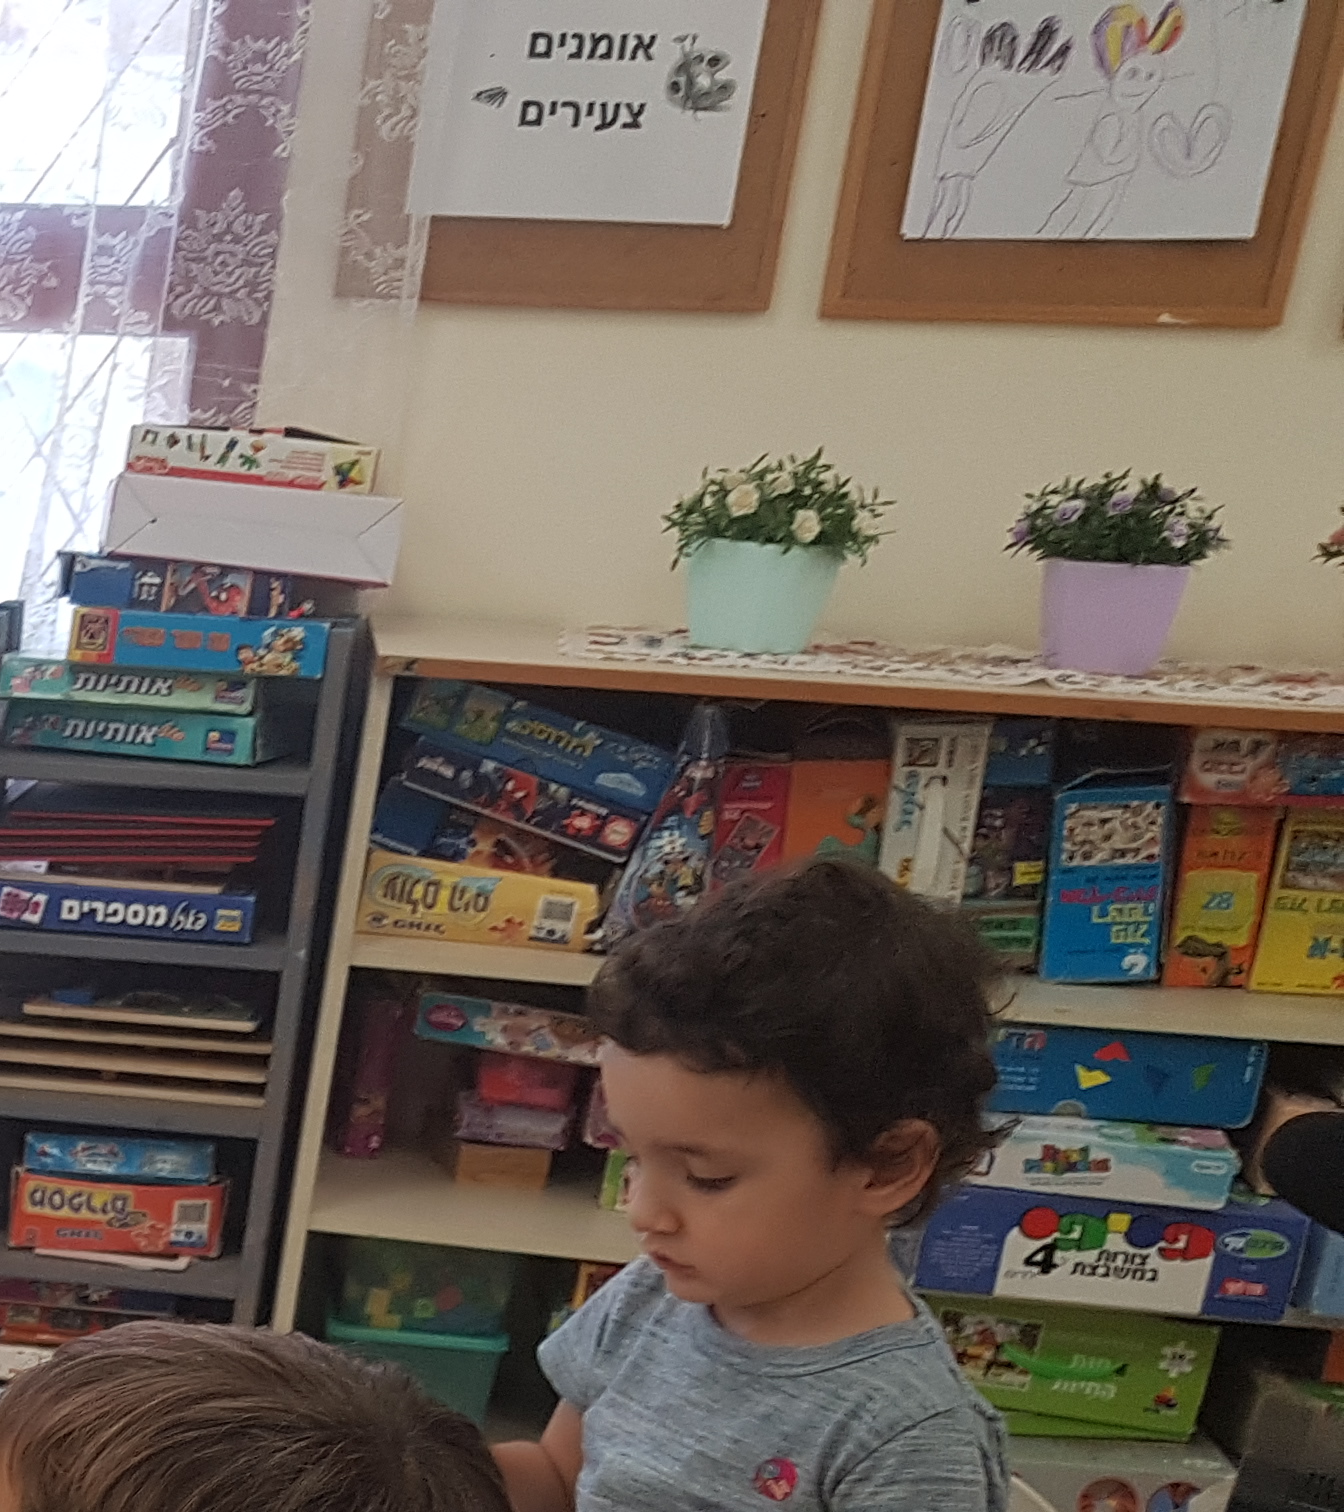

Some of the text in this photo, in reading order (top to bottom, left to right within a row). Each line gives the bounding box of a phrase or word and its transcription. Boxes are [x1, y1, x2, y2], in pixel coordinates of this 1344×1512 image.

[528, 32, 658, 61] אומנים
[518, 100, 647, 132] צעירים
[71, 671, 174, 696] אותיות
[61, 717, 159, 745] אותיות
[60, 899, 169, 928] מספרים
[1023, 1243, 1060, 1274] 4
